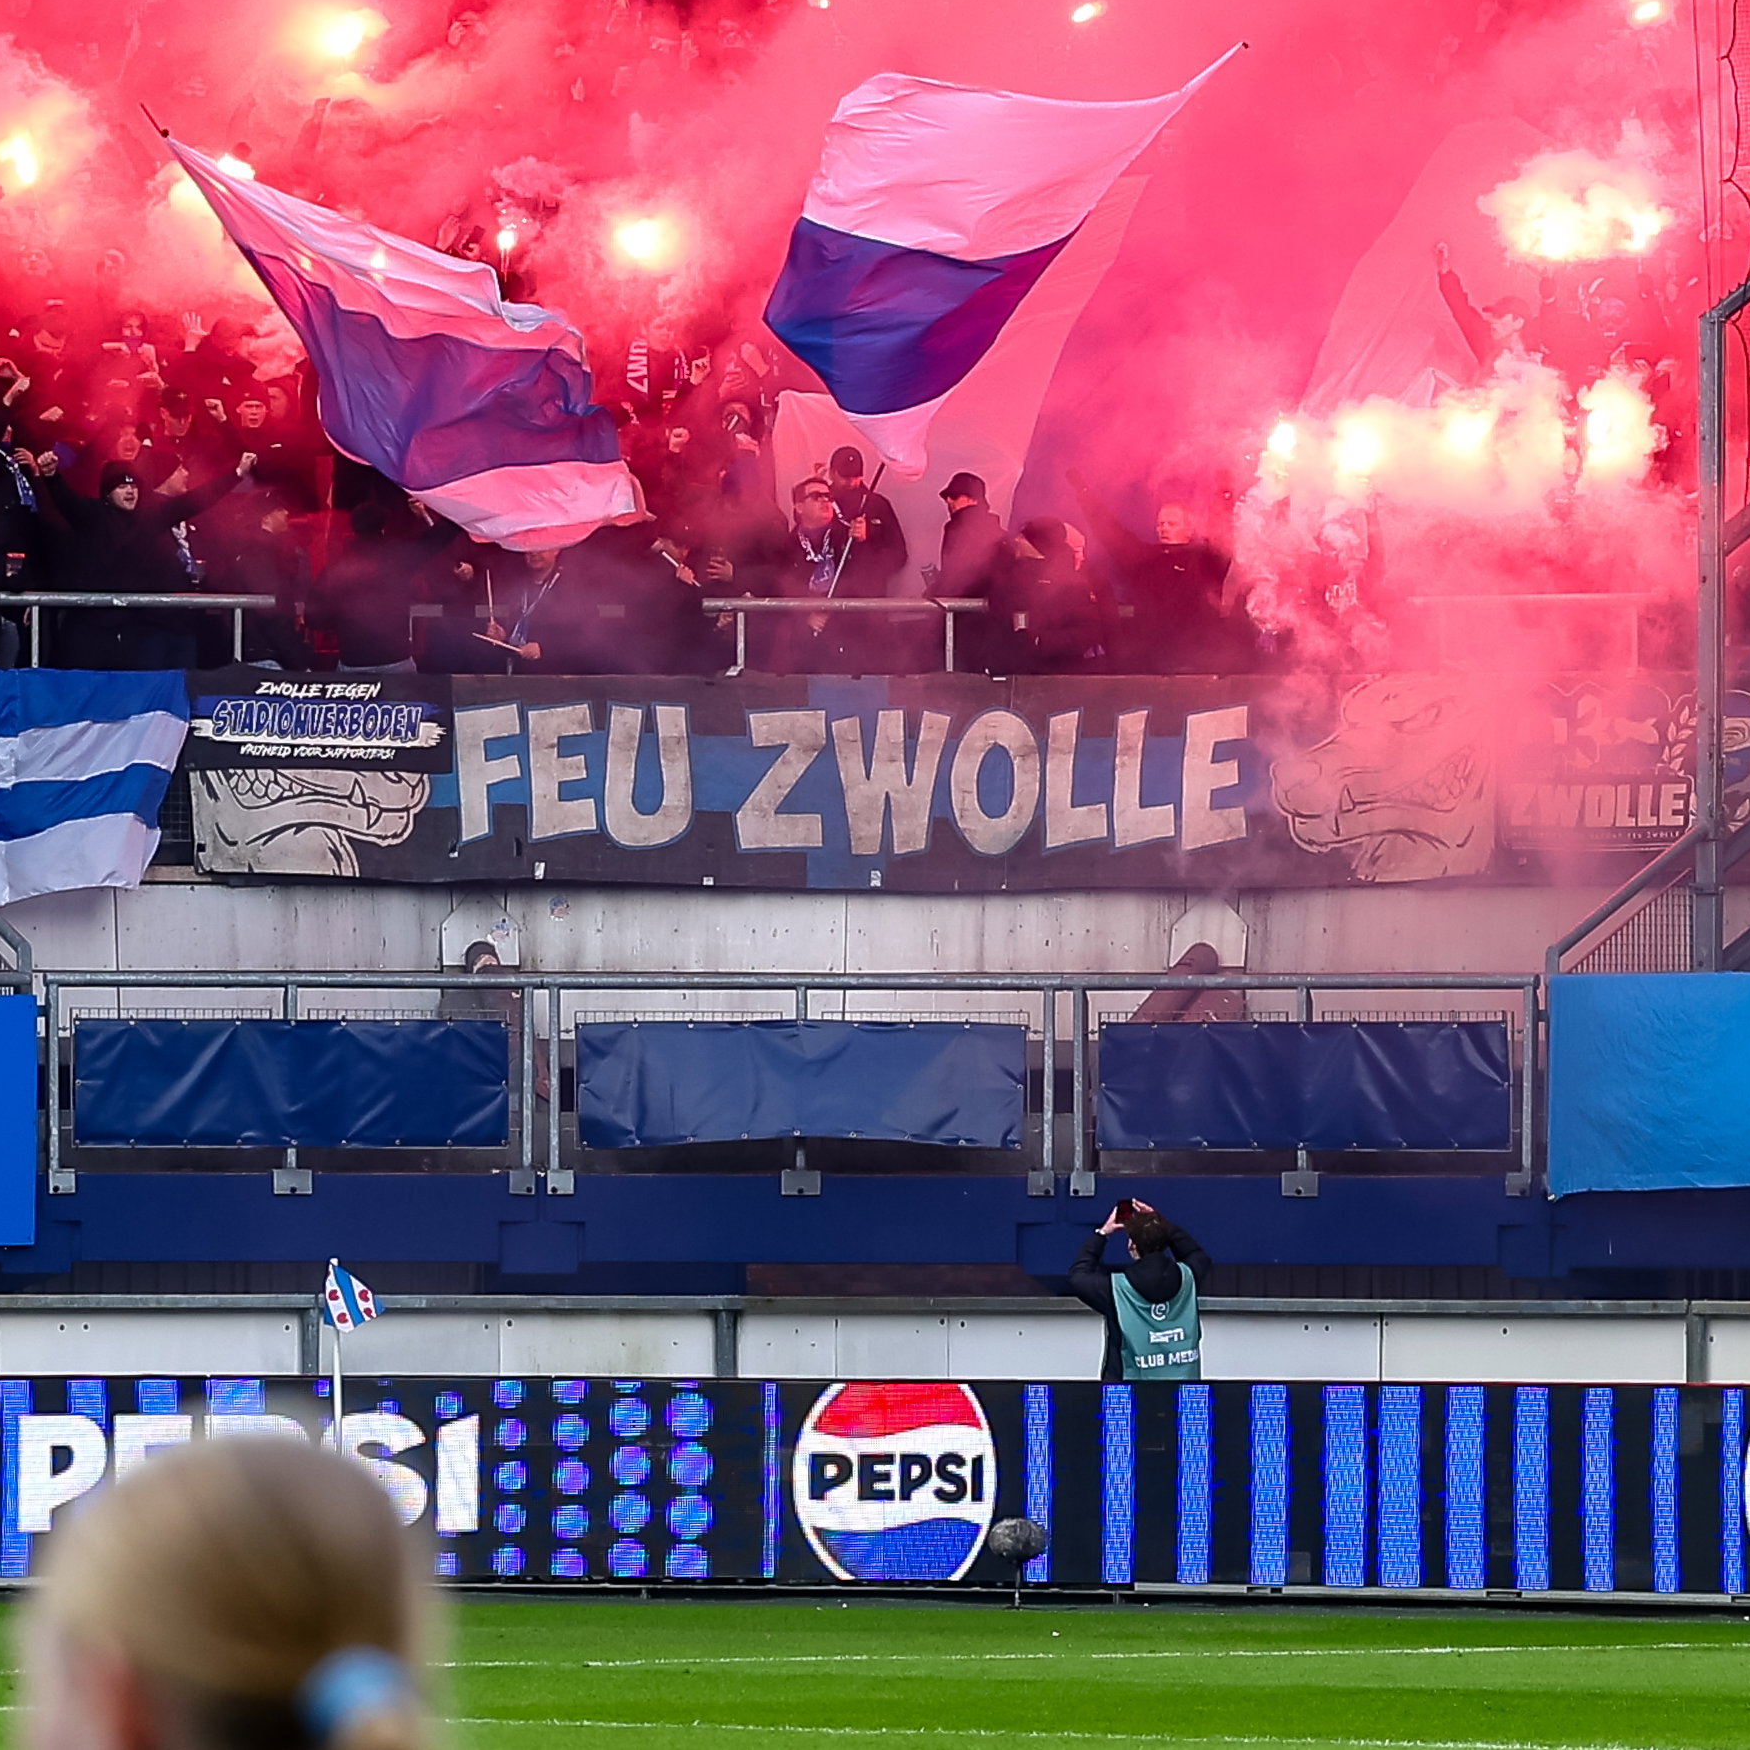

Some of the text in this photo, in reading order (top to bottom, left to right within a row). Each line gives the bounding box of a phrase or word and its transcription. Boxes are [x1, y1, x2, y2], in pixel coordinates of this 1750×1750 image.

[254, 681, 382, 701] ZWOLLE TEGEN
[212, 700, 424, 742] STADIONVERBODEN
[453, 700, 1249, 857] FEU ZWOLLE
[1509, 782, 1687, 828] ZWOLLE
[1135, 1353, 1165, 1368] CLUB
[809, 1451, 984, 1503] PEPSI
